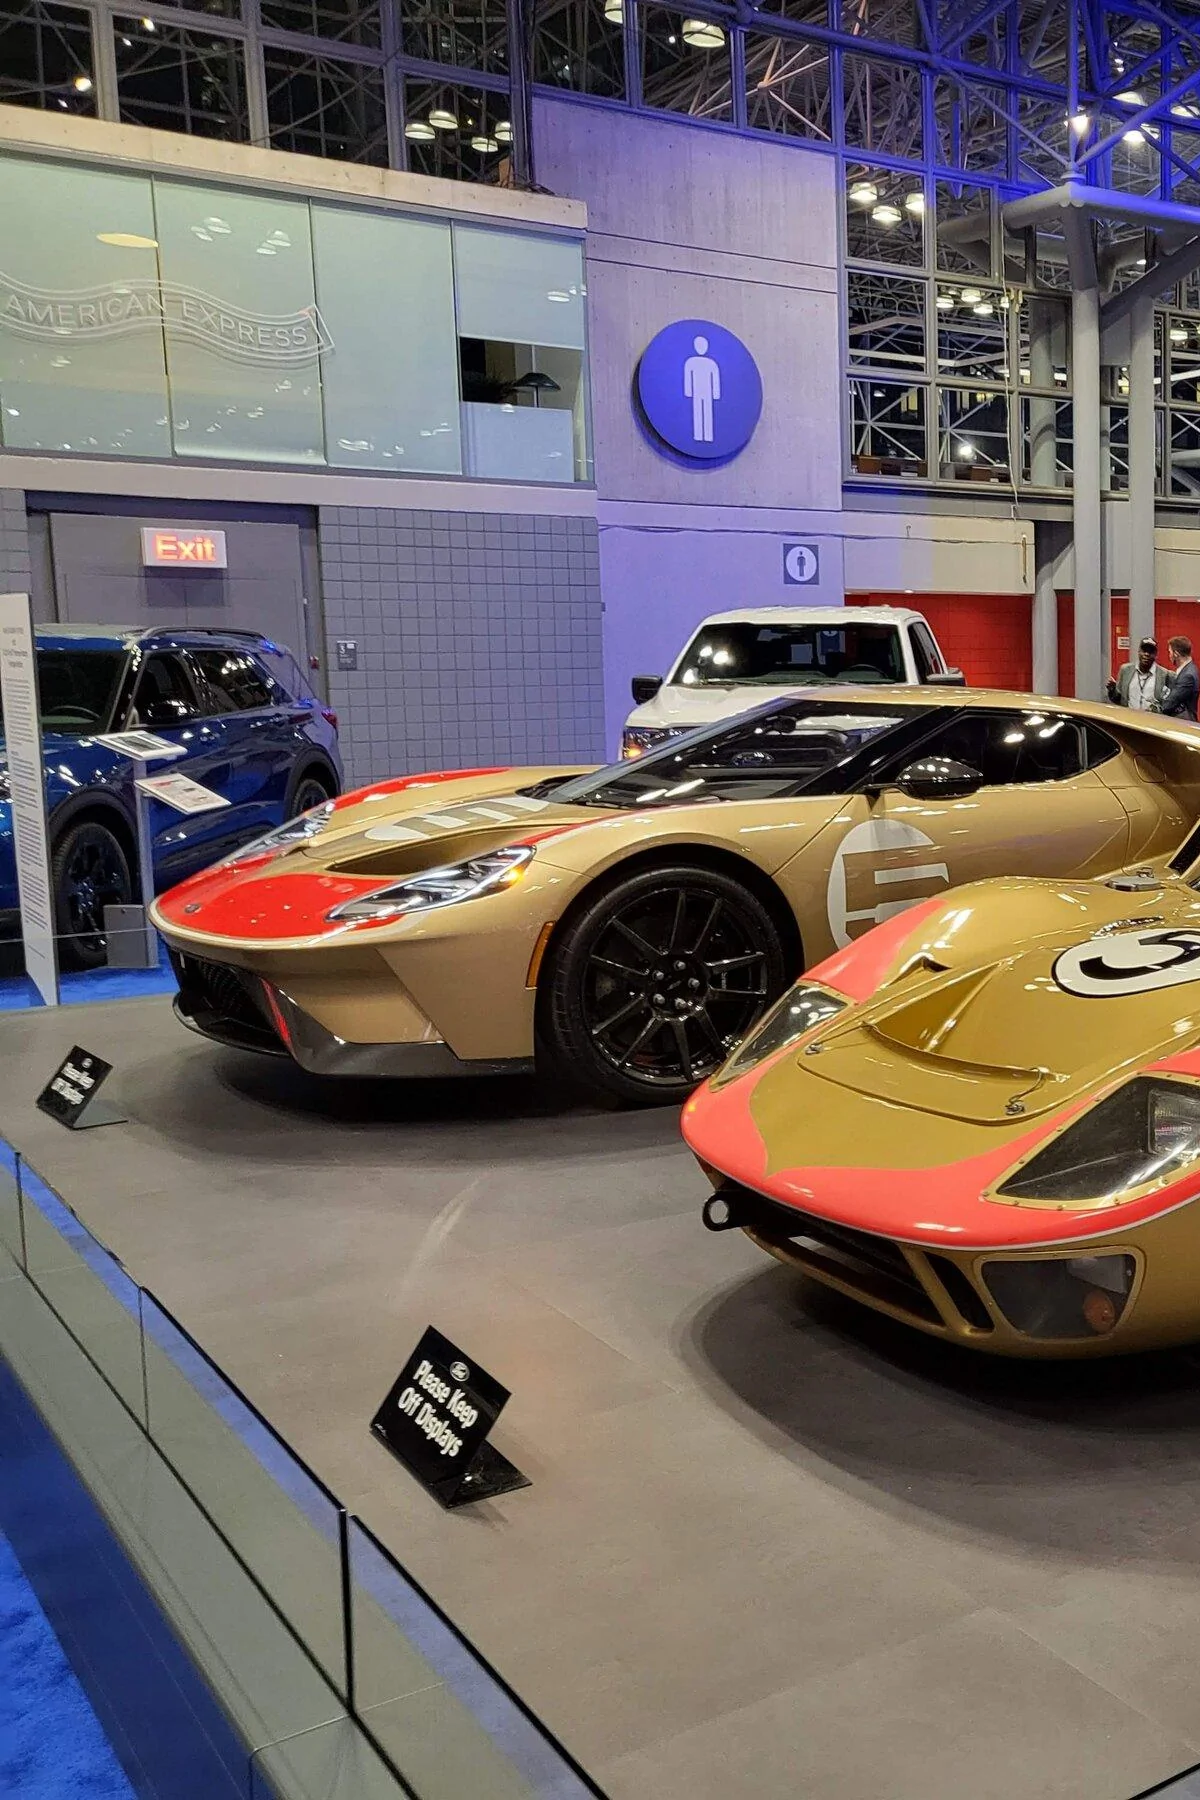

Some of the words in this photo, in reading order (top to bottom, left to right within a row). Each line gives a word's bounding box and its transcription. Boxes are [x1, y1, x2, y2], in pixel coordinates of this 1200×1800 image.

[8, 293, 167, 325] AMERICAN
[182, 299, 308, 347] EXPRESS
[154, 534, 216, 561] Exit
[398, 1387, 424, 1416] Off
[414, 1402, 463, 1457] Displays
[413, 1360, 451, 1403] Please
[446, 1389, 478, 1428] Keep
